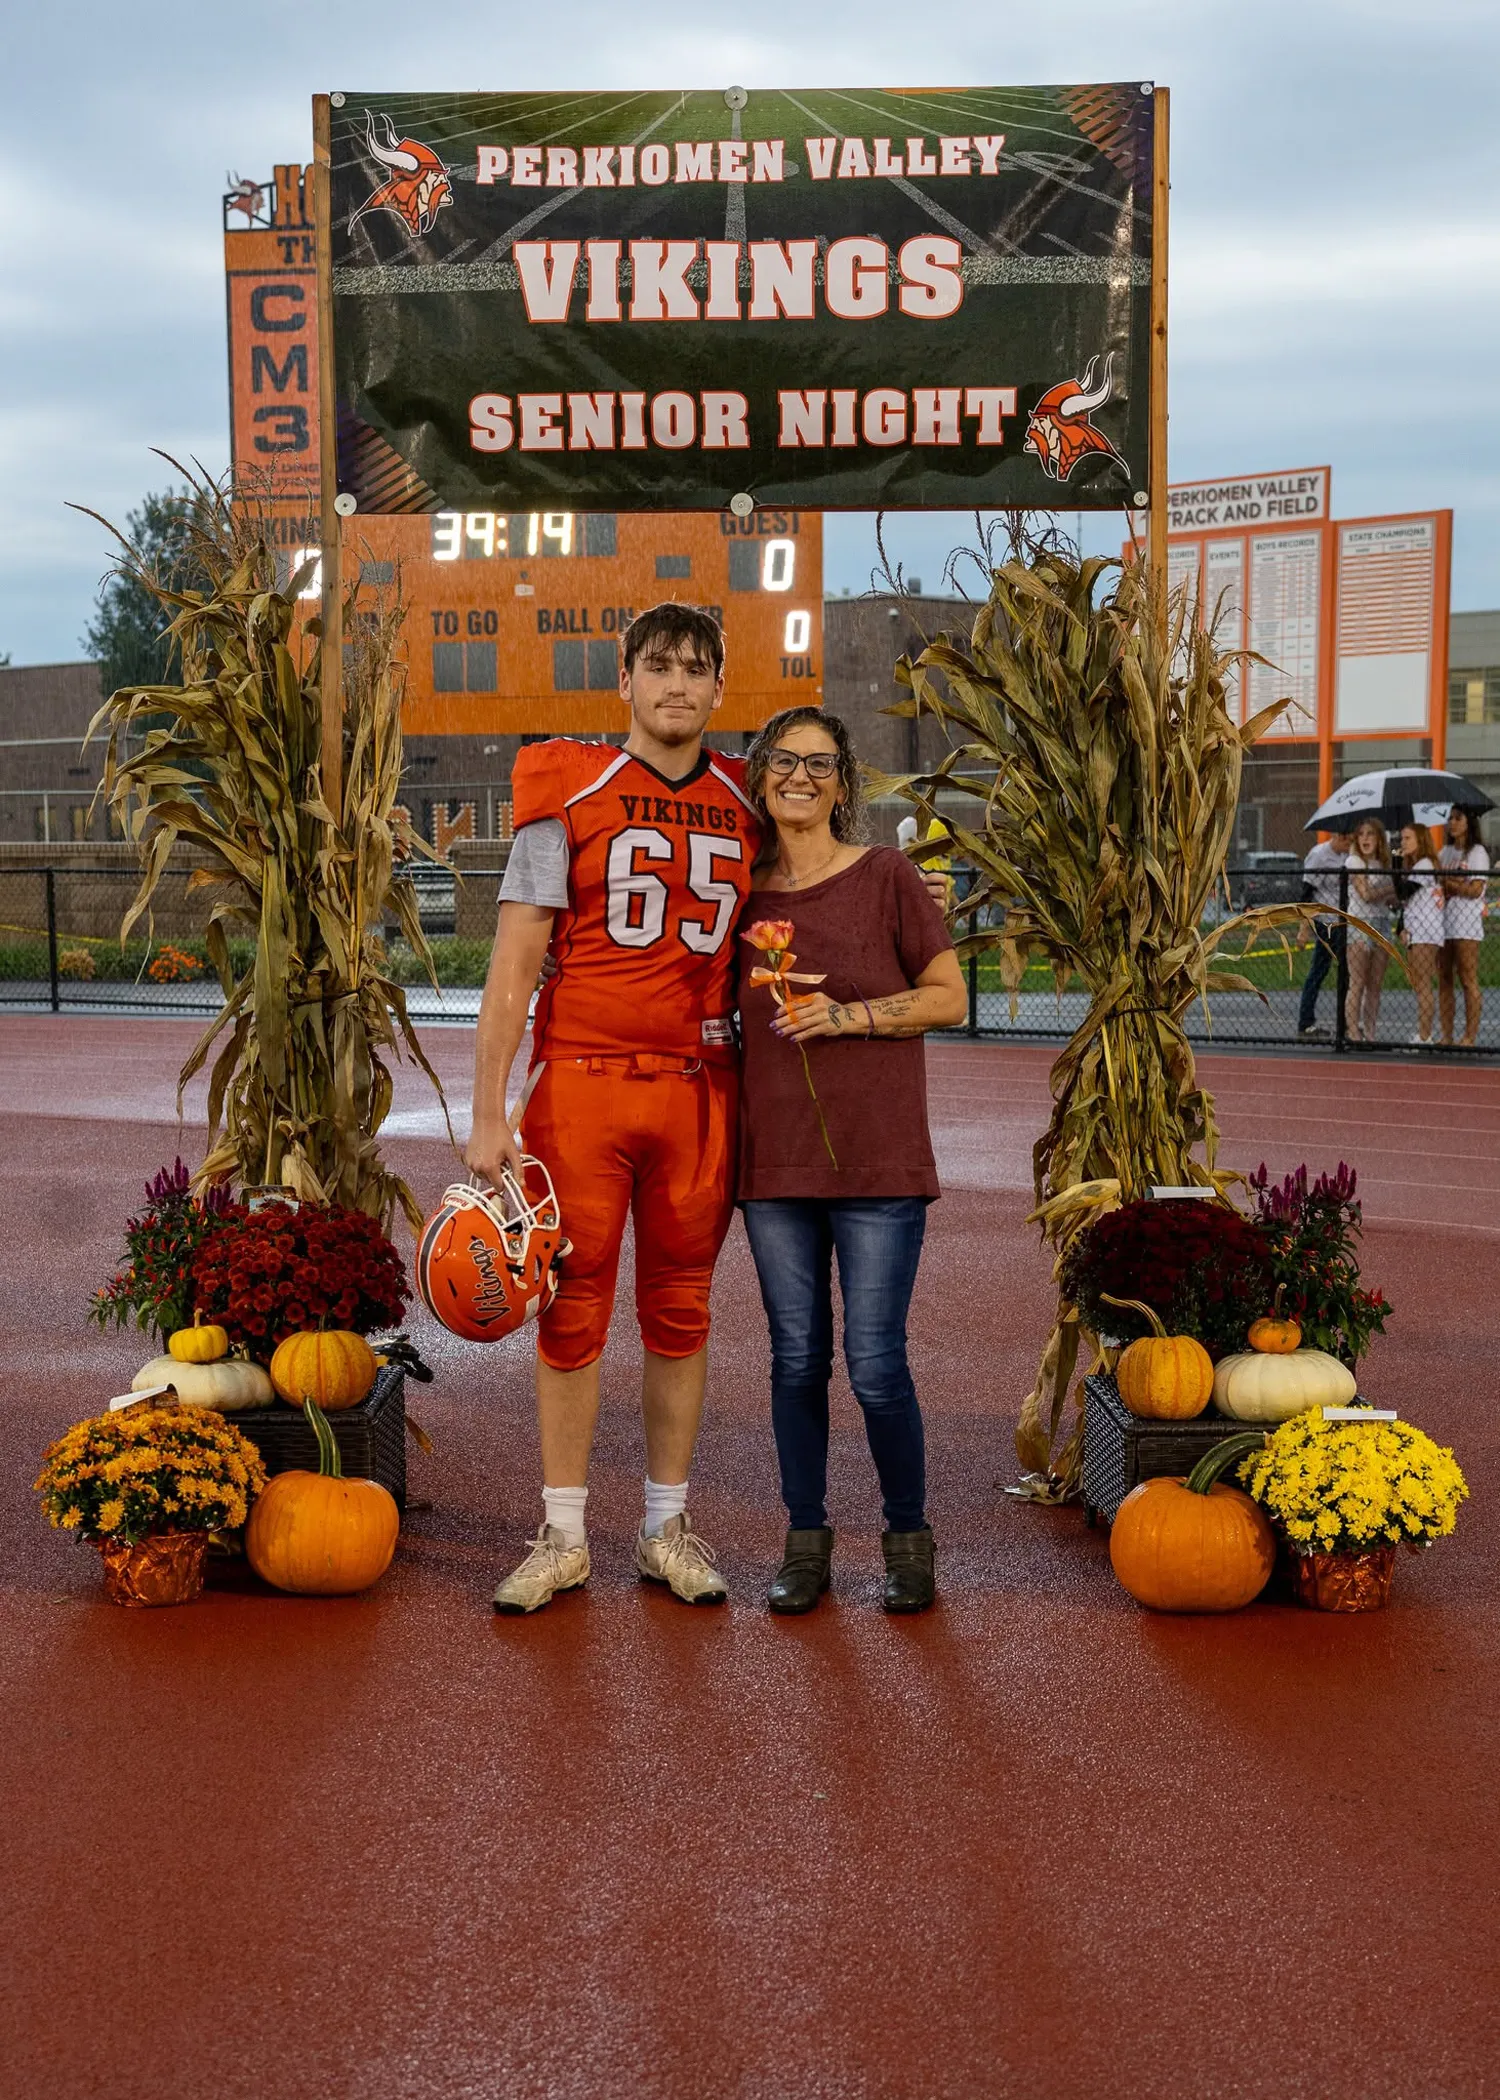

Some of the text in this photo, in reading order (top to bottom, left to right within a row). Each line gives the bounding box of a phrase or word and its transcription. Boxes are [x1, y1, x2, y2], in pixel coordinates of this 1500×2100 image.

[477, 135, 1006, 187] PERKIOMEN VALLEY
[512, 235, 964, 323] VIKINGS
[468, 386, 1018, 453] SENIOR NIGHT
[1257, 476, 1320, 498] VALLEY
[1223, 502, 1262, 522] AND
[1267, 496, 1319, 517] FIELD
[721, 512, 799, 535] GUEST
[1348, 527, 1426, 542] STATE CHAMPIONS
[1209, 551, 1240, 560] EVENTS
[1278, 538, 1315, 549] RECORDS
[762, 539, 795, 592] 0
[431, 609, 499, 636] TO GO
[537, 607, 594, 635] BALL
[784, 610, 810, 653] 0
[779, 656, 816, 679] TOL
[619, 795, 738, 833] VIKINGS
[606, 826, 742, 955] 65
[468, 1234, 512, 1329] Vikings
